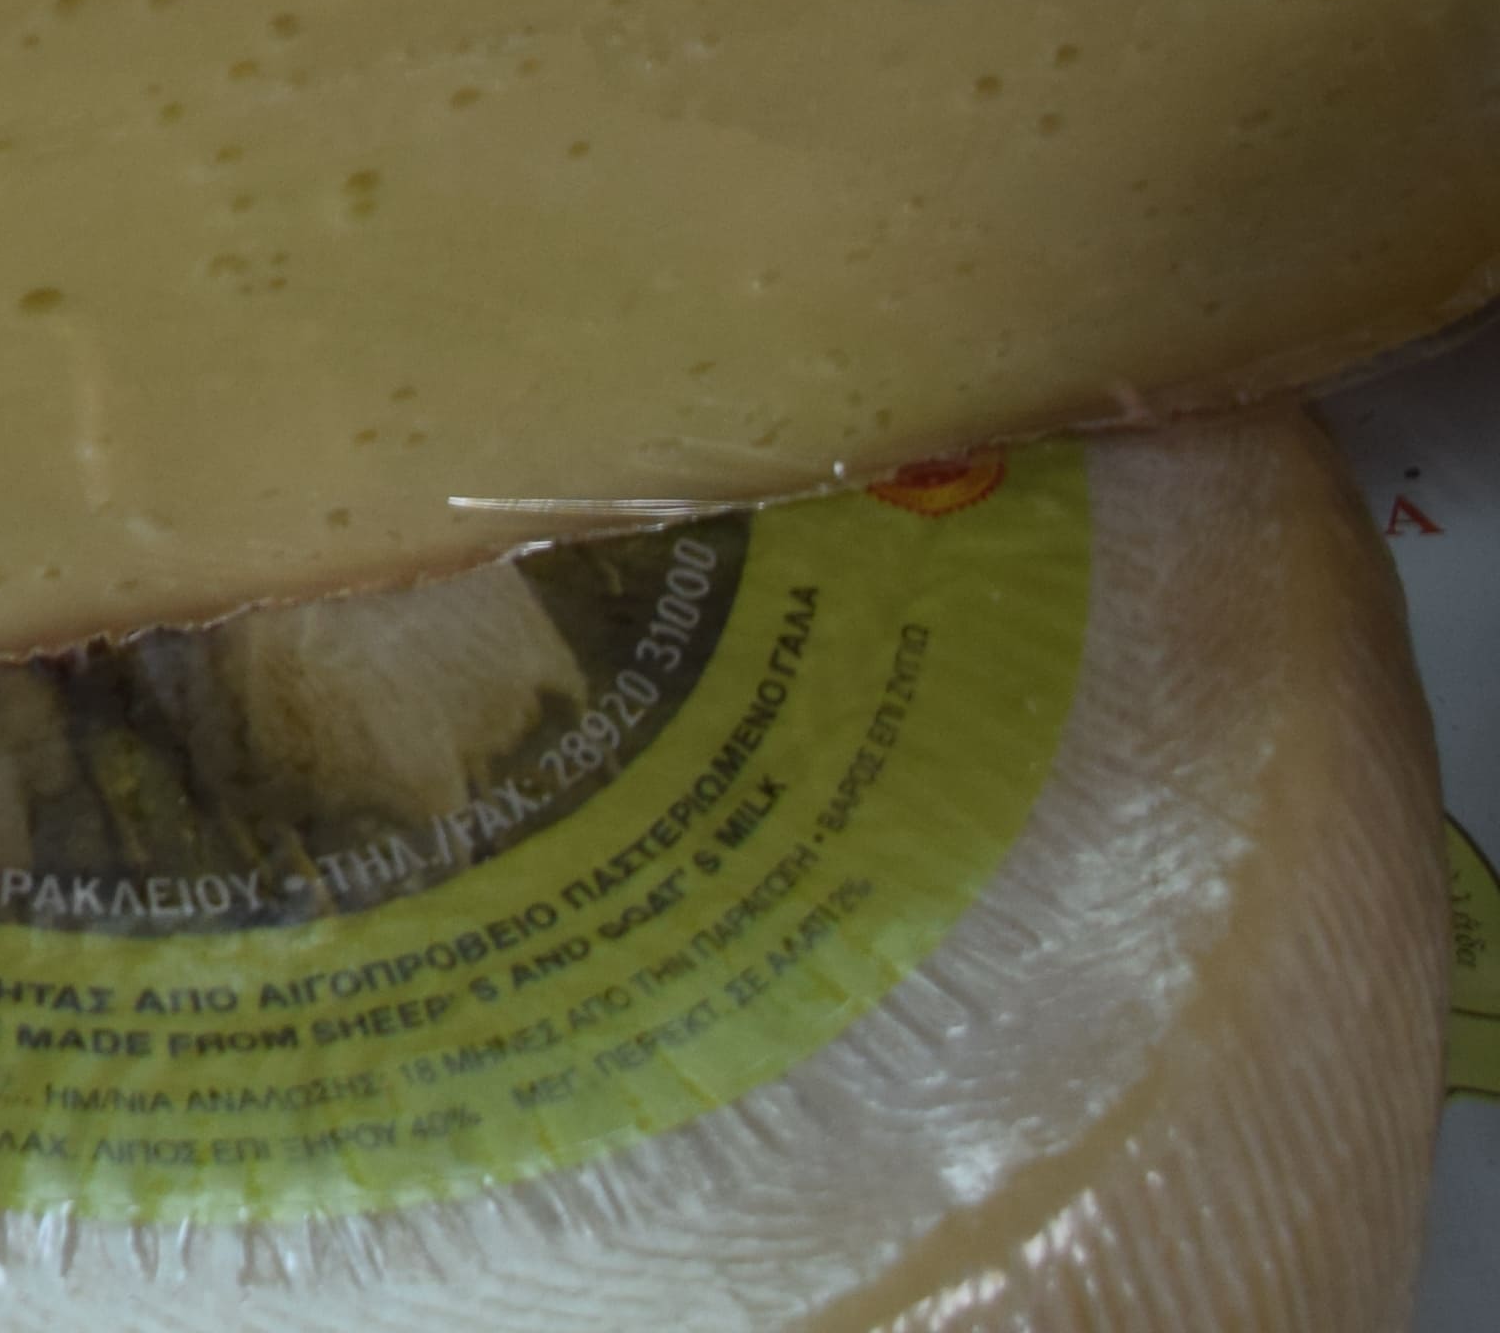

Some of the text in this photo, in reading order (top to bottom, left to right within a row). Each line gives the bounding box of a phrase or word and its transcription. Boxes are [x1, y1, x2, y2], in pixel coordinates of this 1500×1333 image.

[539, 668, 660, 791] 28920
[635, 536, 717, 672] 31000
[17, 1024, 153, 1056] MADE
[167, 1029, 297, 1056] FROM
[509, 940, 591, 989] AND
[715, 775, 787, 853] MILK
[135, 987, 238, 1014] ΑΠΟ
[258, 902, 559, 1012] ΑΙΓΟΠΡΟΒΕΙΟ
[564, 682, 787, 910] ΠΑΣΤΕΡΙΩΜΕΝΟ
[770, 585, 820, 682] ΓΑΛΑ
[440, 1018, 565, 1078] ΜΗΝΕΣ
[566, 985, 632, 1033] ΑΠΟ
[630, 951, 699, 1008] ΤΗΝ
[693, 840, 820, 959] ΠΑΡΑΓΩΓΗ
